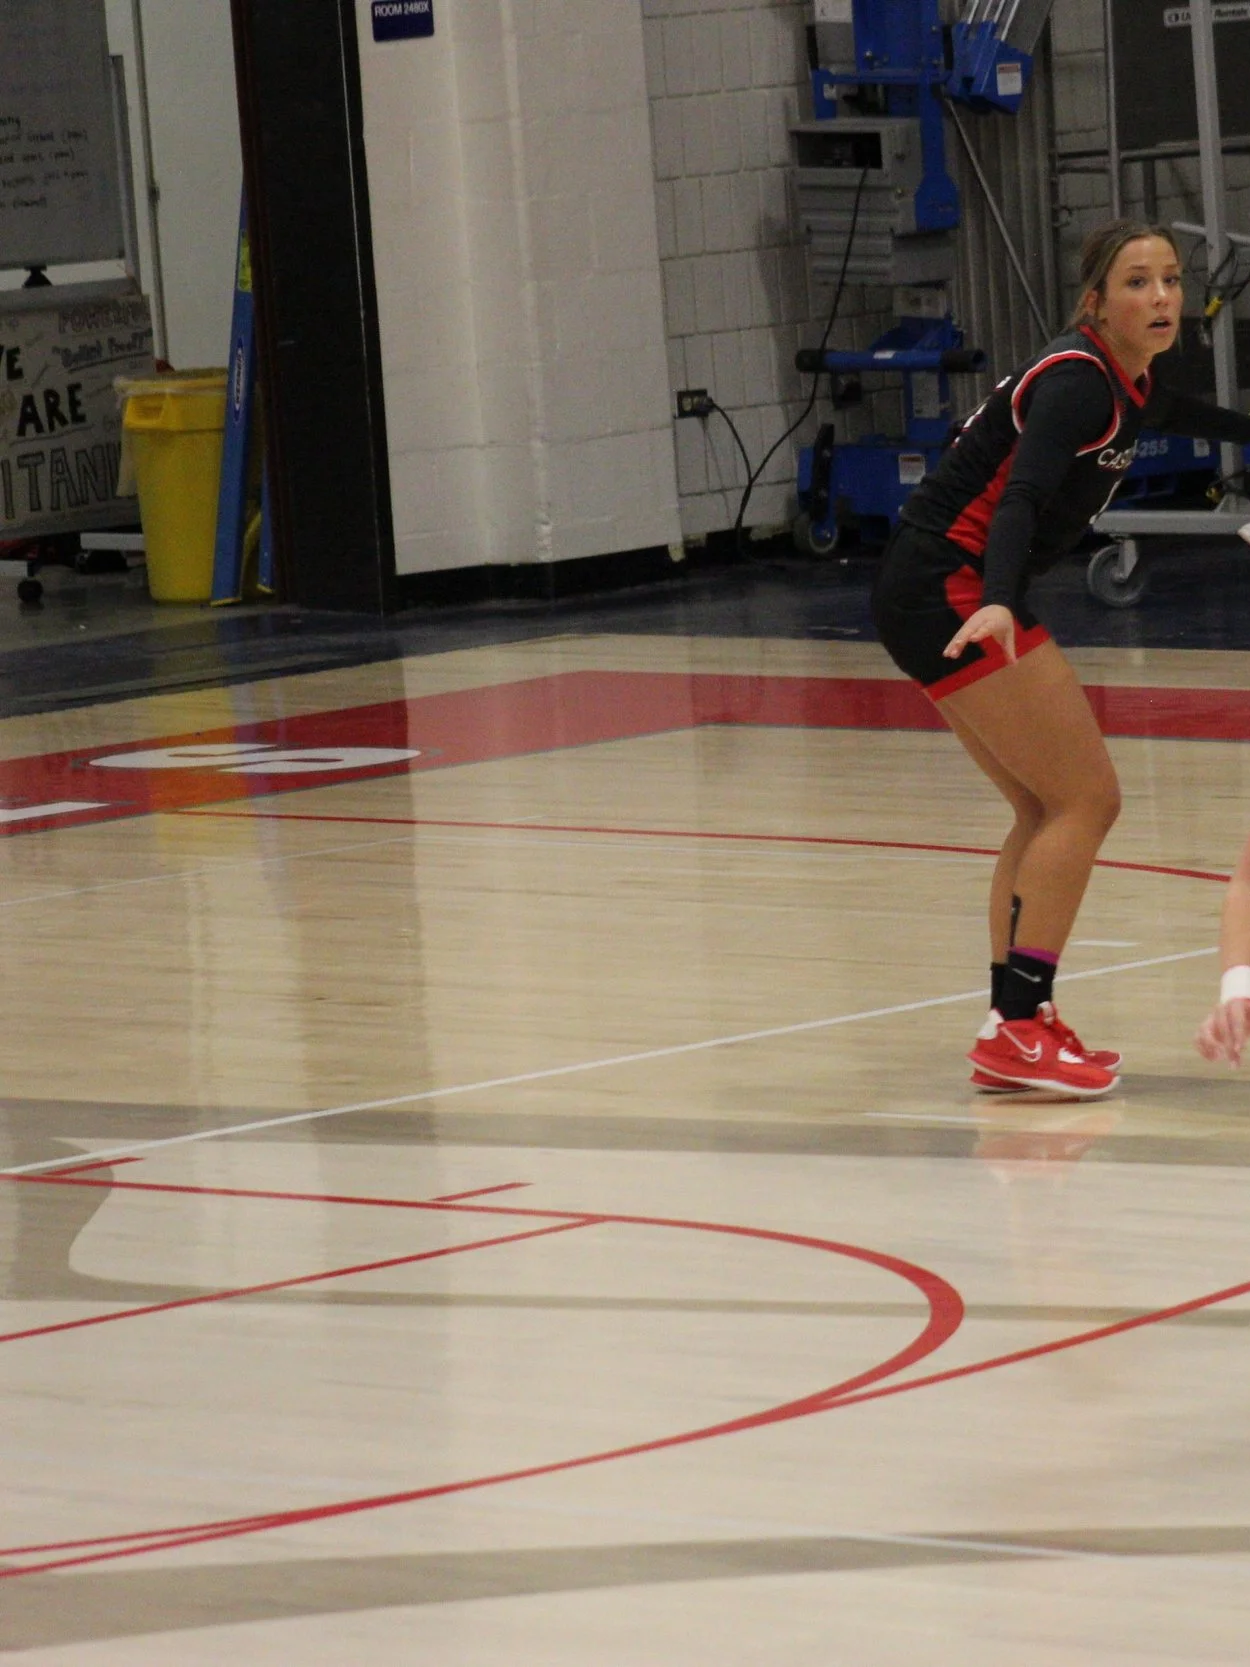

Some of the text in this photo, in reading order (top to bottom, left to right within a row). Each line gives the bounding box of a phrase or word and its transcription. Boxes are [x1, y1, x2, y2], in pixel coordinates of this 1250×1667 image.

[374, 4, 402, 17] ROOM
[0, 344, 24, 382] E
[16, 382, 87, 437] ARE
